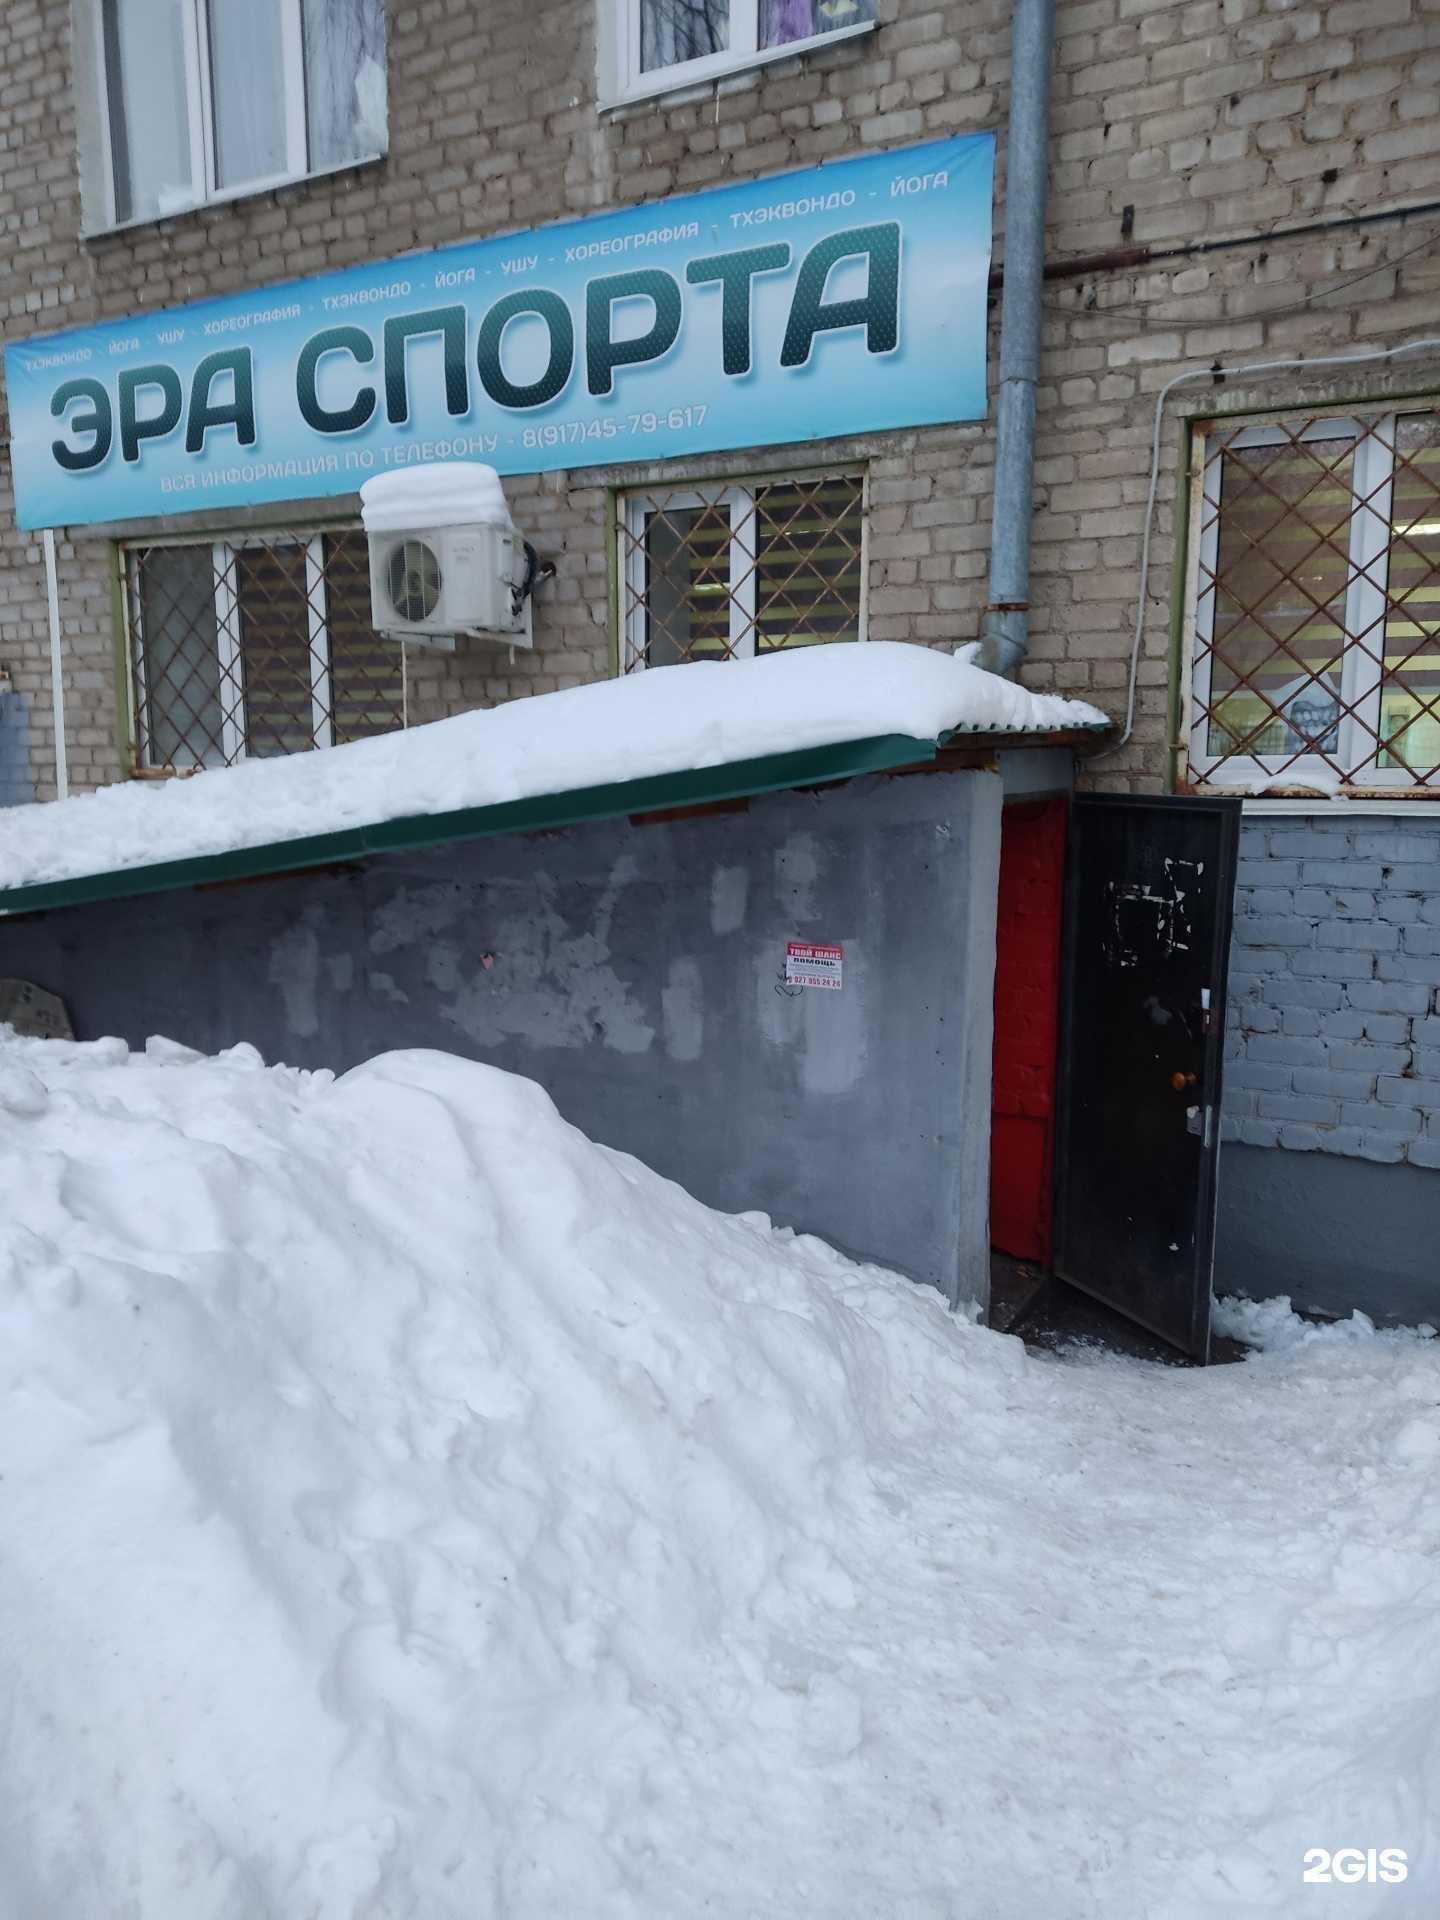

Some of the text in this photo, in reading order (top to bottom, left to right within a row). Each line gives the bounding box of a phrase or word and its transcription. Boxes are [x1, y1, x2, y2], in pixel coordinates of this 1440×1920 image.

[49, 220, 903, 475] ЭРА СПОРТА
[108, 337, 140, 356] ЙОГА
[157, 328, 185, 346] УШУ
[203, 303, 301, 336] ХОРЕОГРАФИЯ
[322, 280, 412, 312] ТХЭКВОНДО
[435, 268, 475, 289] ЙОГА
[501, 255, 538, 276] УШУ
[565, 222, 699, 263] ХОРЕОГРАФИЯ
[730, 189, 856, 229] ТХЭКВОНДО
[890, 170, 949, 199] ЙОГА
[160, 404, 708, 493] ВСЯ ИНФОРМАЦИЯ ПО ТЕЛЕФОНУ 8(917)45-79-617
